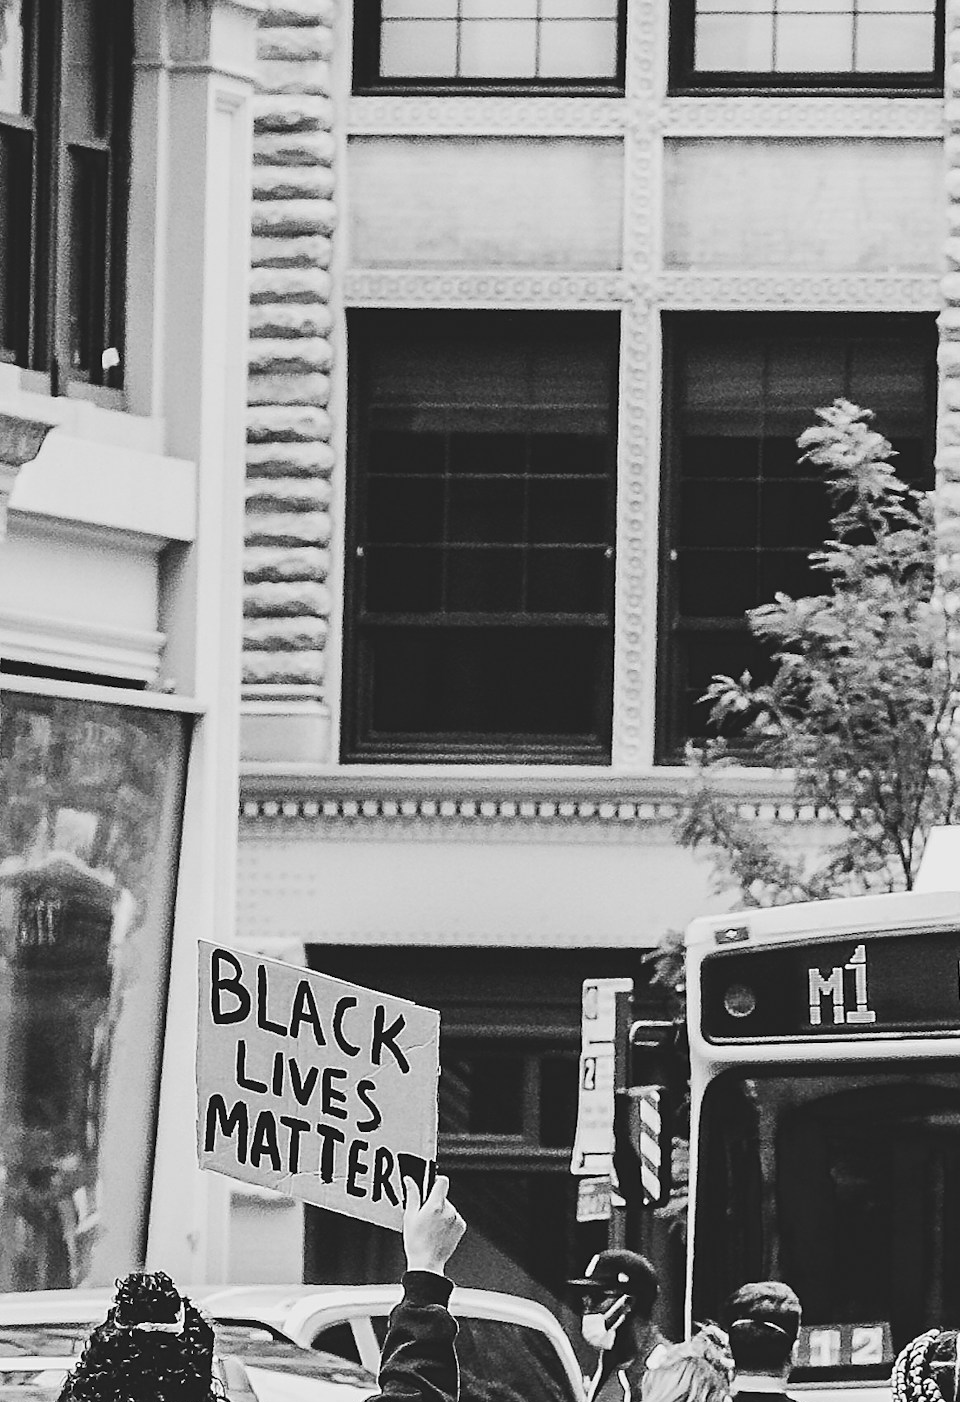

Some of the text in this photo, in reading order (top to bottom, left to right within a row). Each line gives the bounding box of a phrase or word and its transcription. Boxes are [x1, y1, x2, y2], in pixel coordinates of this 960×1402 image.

[211, 949, 410, 1074] BLACK
[808, 945, 877, 1024] M1
[236, 1040, 382, 1132] LIVES
[204, 1094, 399, 1206] MATTER
